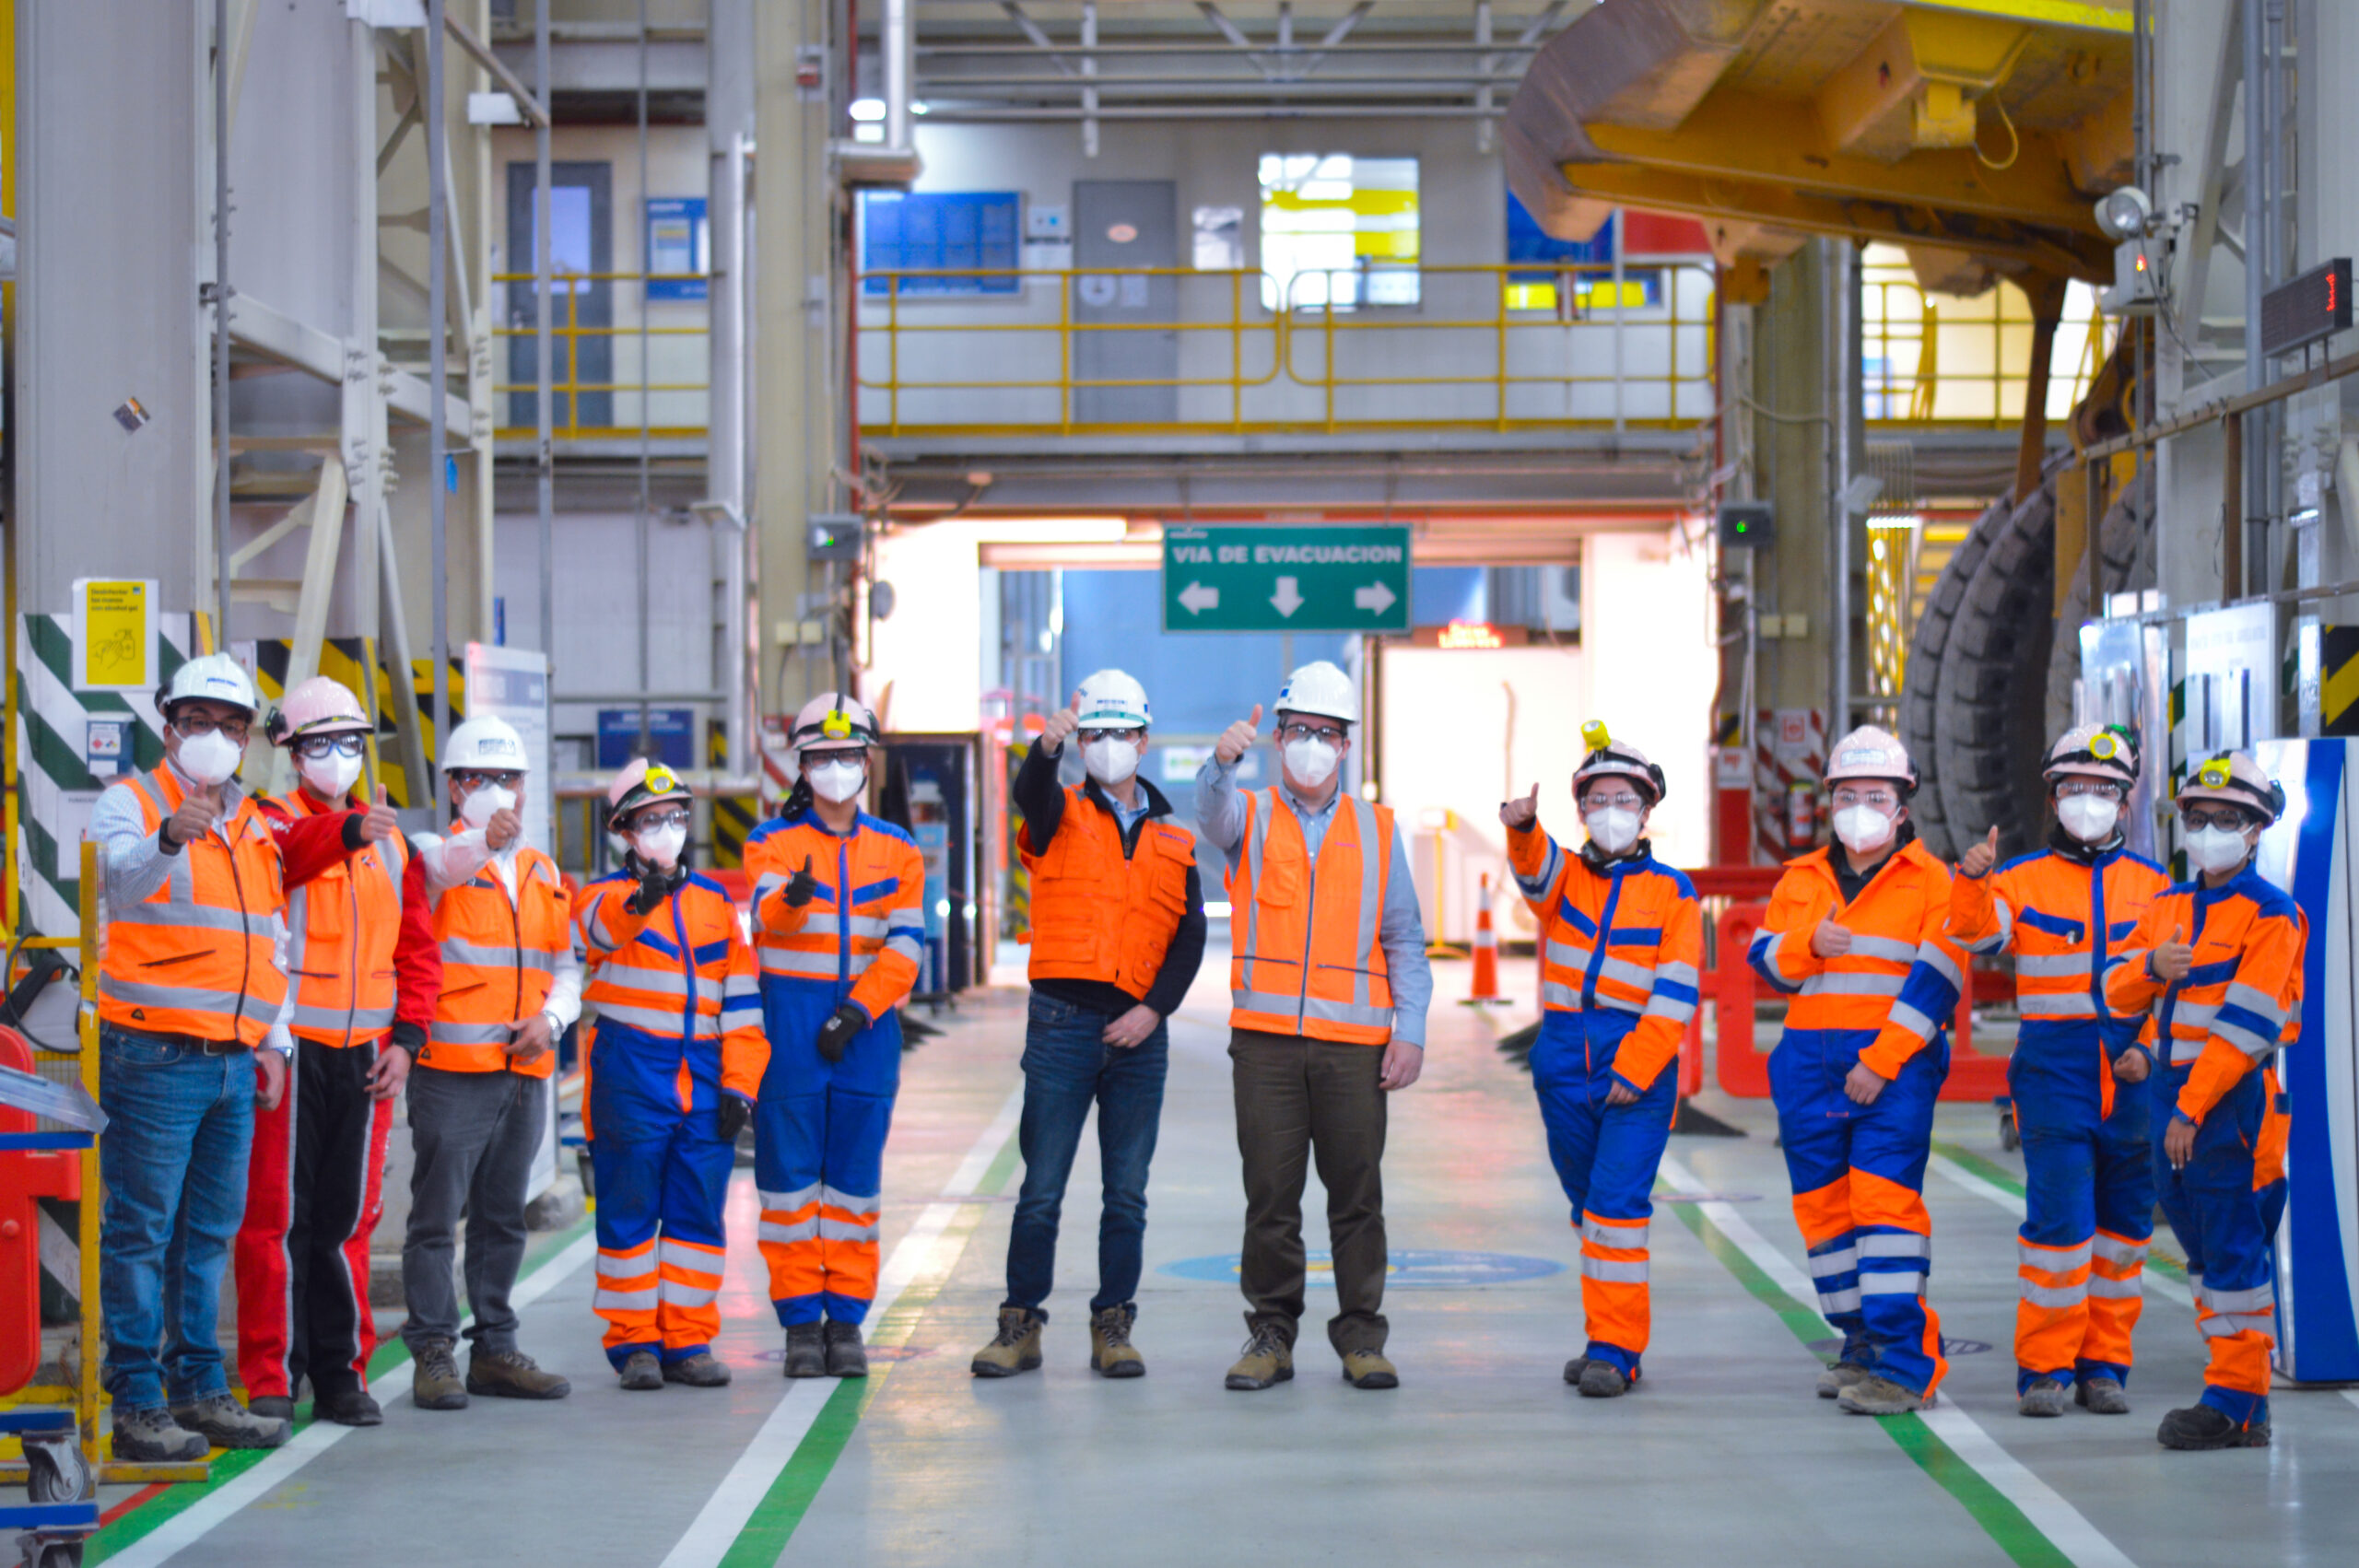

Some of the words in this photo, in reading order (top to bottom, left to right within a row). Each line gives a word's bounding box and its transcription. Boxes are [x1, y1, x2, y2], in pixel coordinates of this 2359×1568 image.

[1172, 545, 1213, 563] VIA
[1217, 545, 1249, 563] DE
[1254, 545, 1402, 563] EVACUACION
